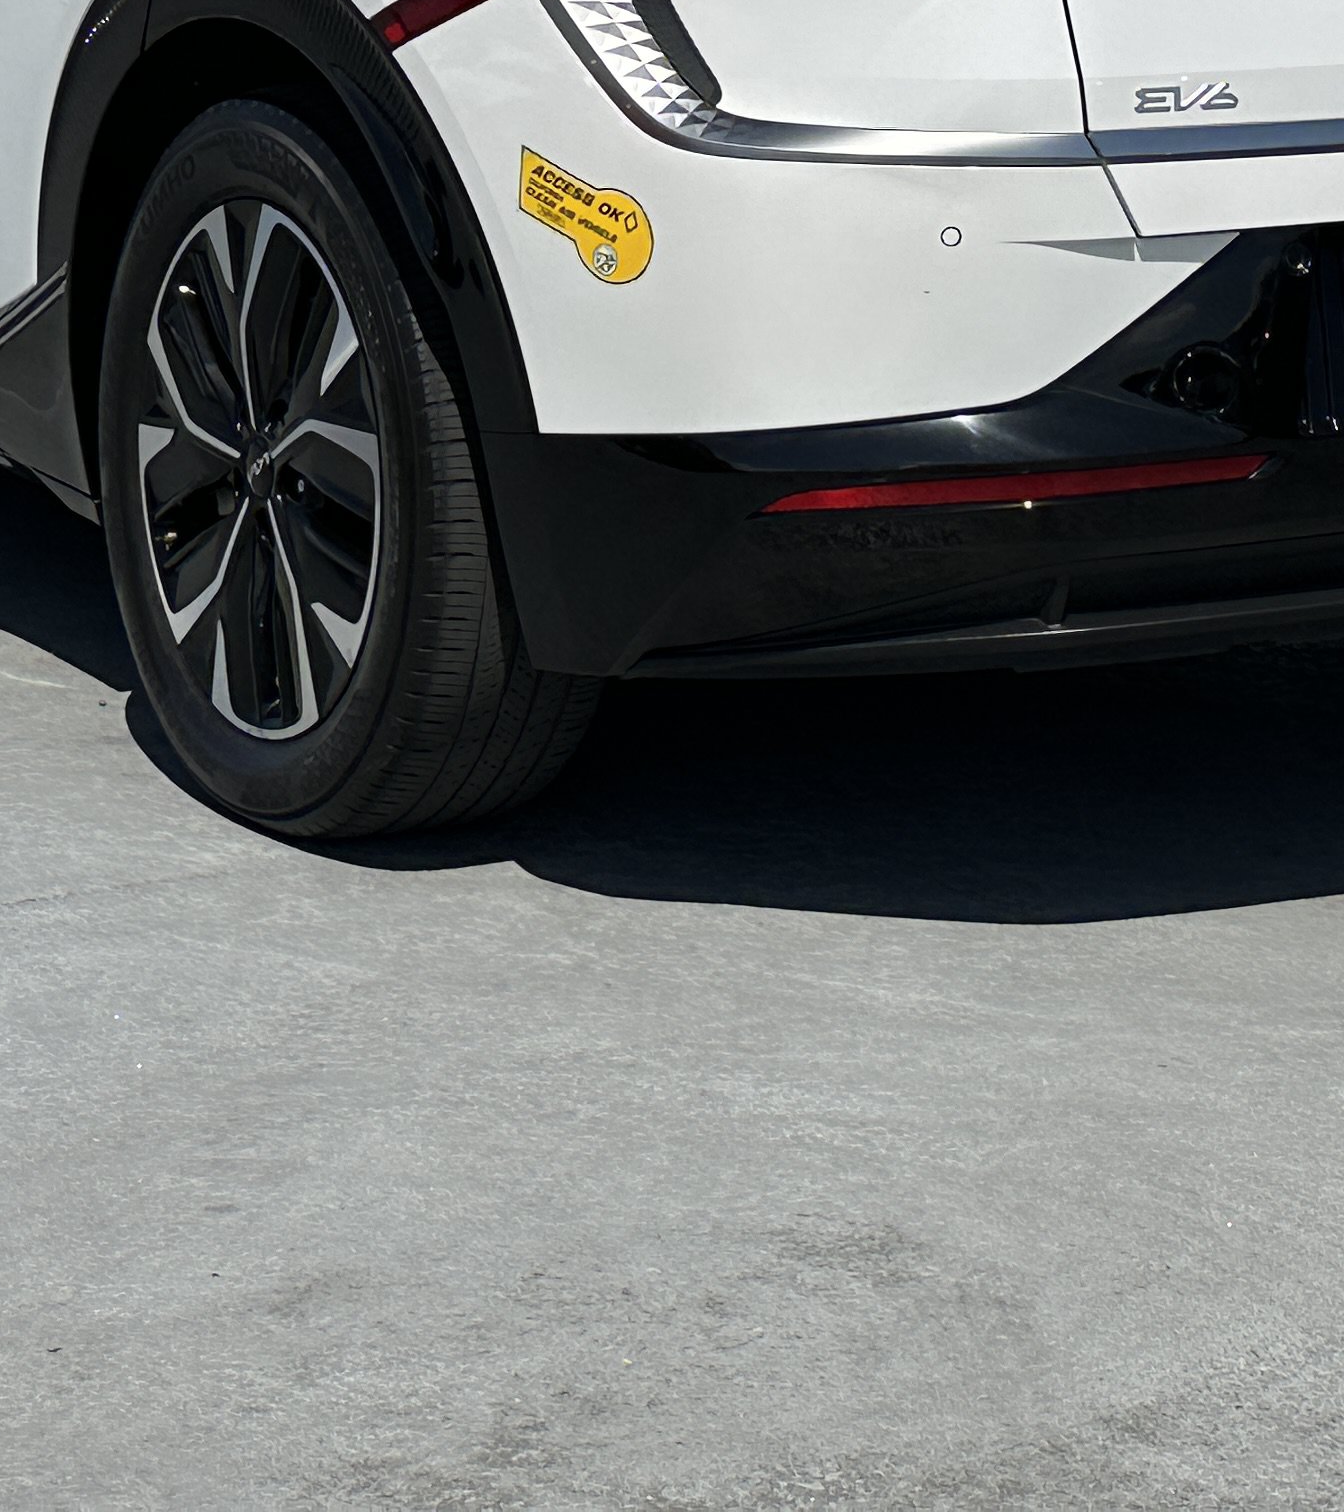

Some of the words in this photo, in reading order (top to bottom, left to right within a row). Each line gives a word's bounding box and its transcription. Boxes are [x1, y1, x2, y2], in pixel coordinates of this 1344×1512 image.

[1134, 82, 1239, 113] EV6
[531, 165, 596, 207] ACCESS
[598, 202, 625, 222] OK
